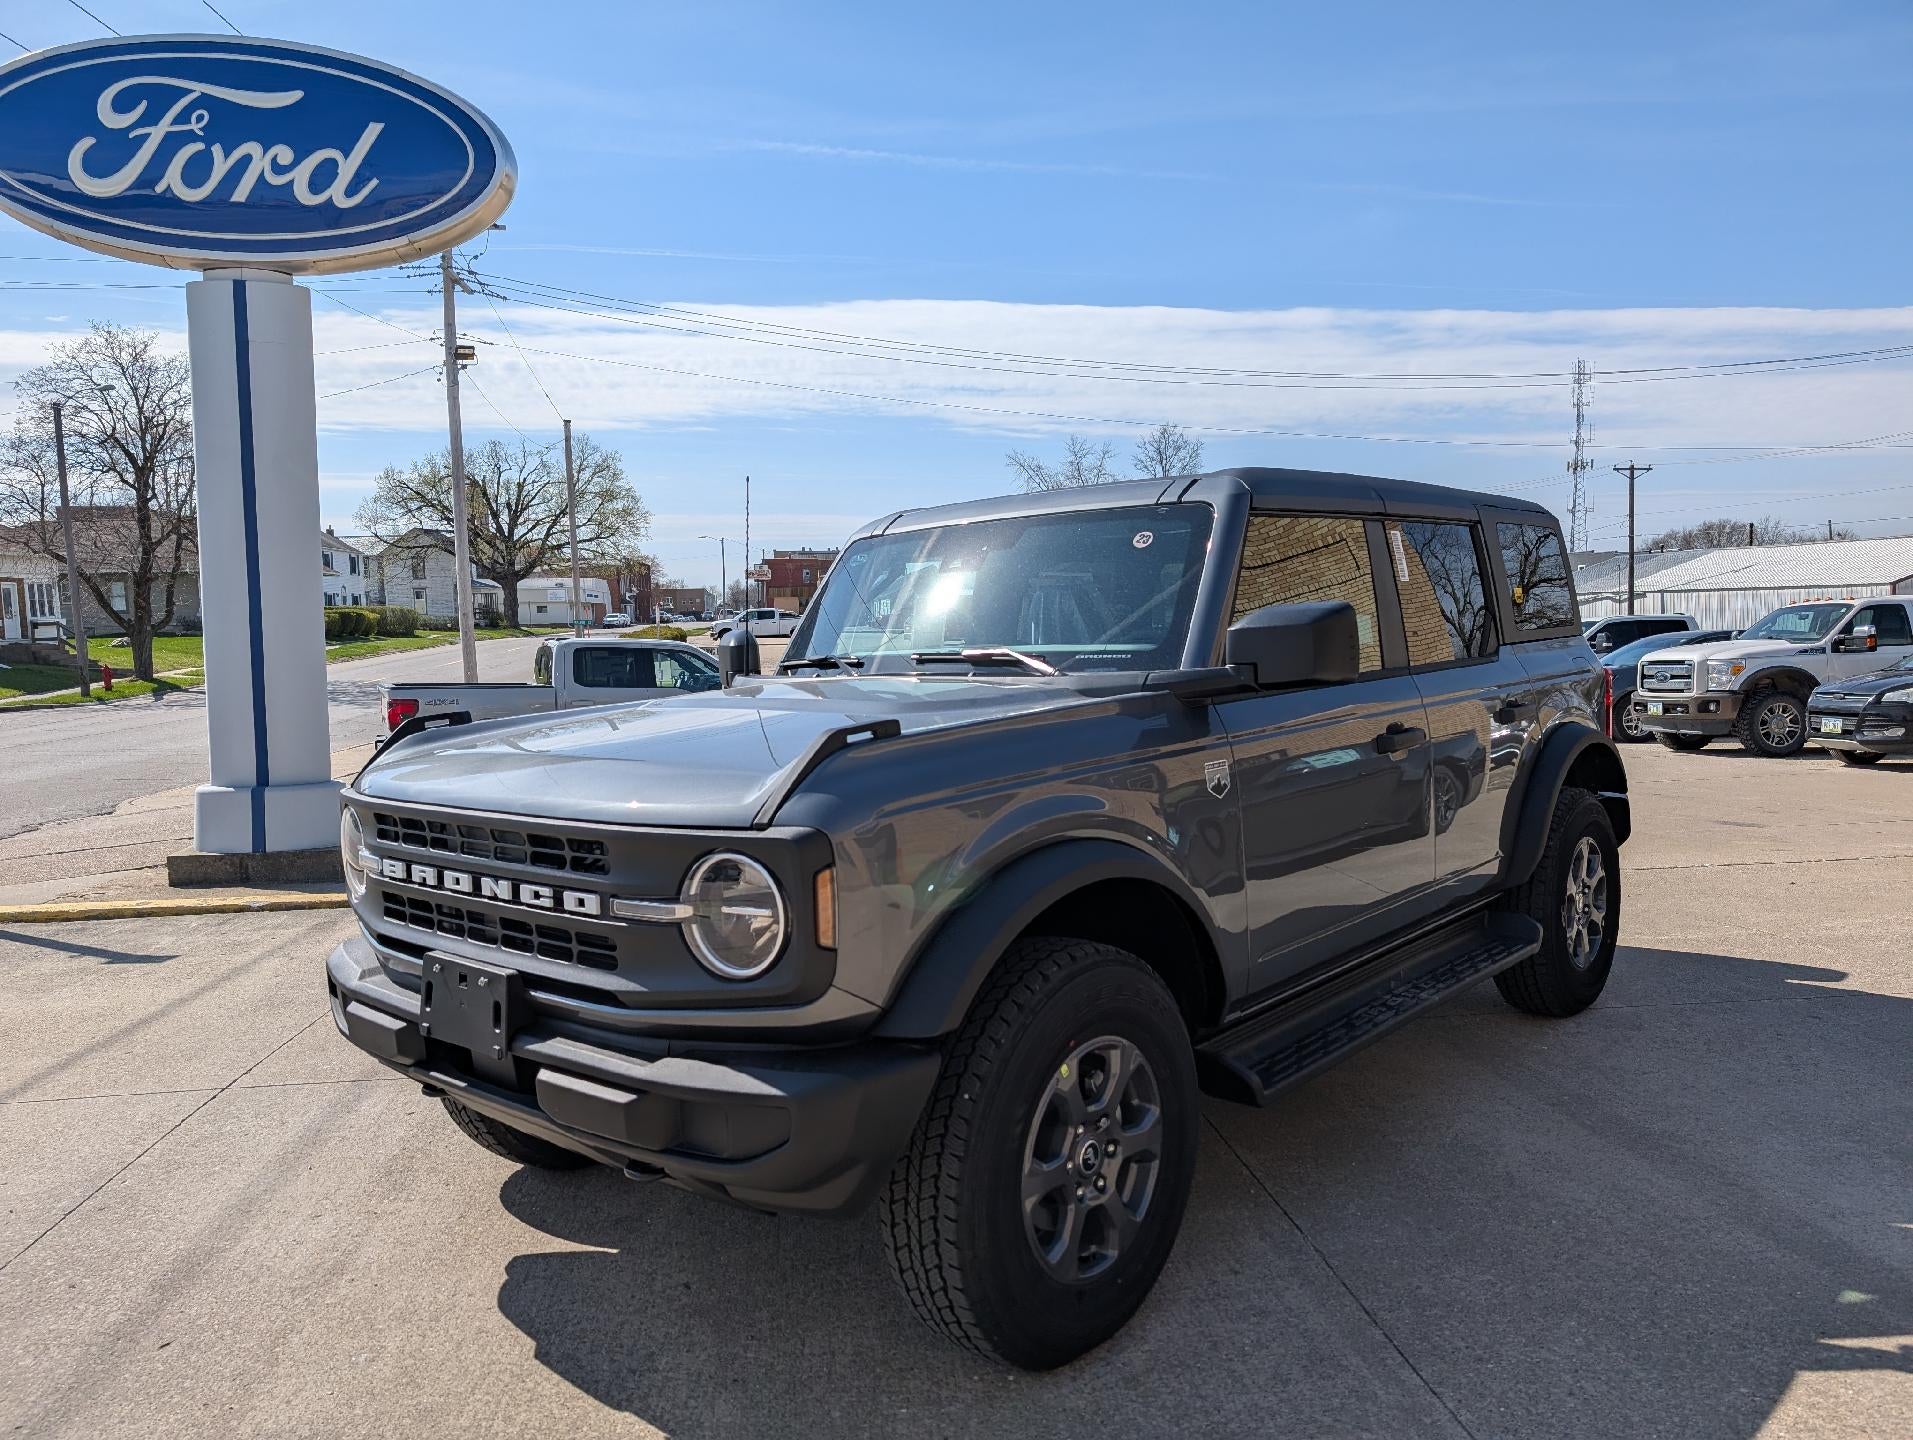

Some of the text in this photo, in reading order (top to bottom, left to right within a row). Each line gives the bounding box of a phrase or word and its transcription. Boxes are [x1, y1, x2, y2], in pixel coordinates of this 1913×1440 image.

[69, 77, 385, 208] Ford
[1136, 533, 1151, 545] 23
[382, 858, 601, 915] BRONCO
